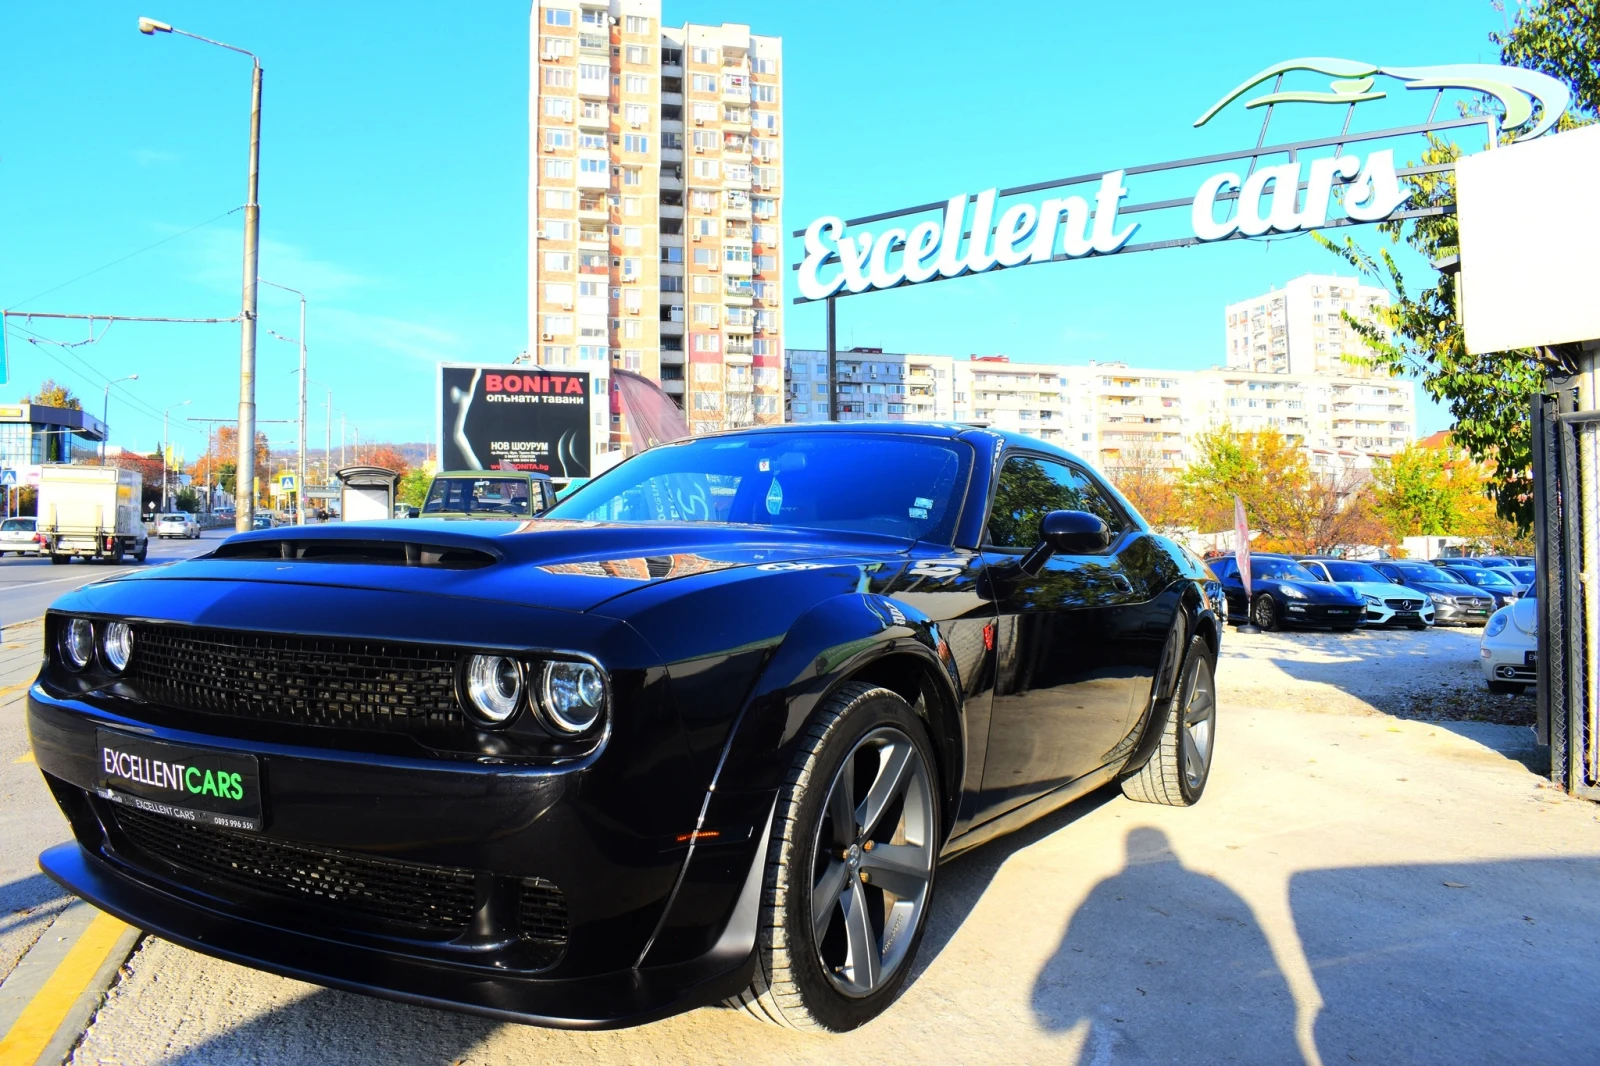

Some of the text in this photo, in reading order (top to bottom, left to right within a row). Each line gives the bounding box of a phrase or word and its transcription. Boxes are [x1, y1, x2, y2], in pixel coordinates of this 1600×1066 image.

[798, 148, 1413, 300] Excellent cars
[486, 375, 583, 394] BONITA
[486, 394, 584, 404] опънати тавани
[491, 441, 549, 451] НОВ ШОУРУМ
[135, 799, 196, 820] EXCELLENT CARS
